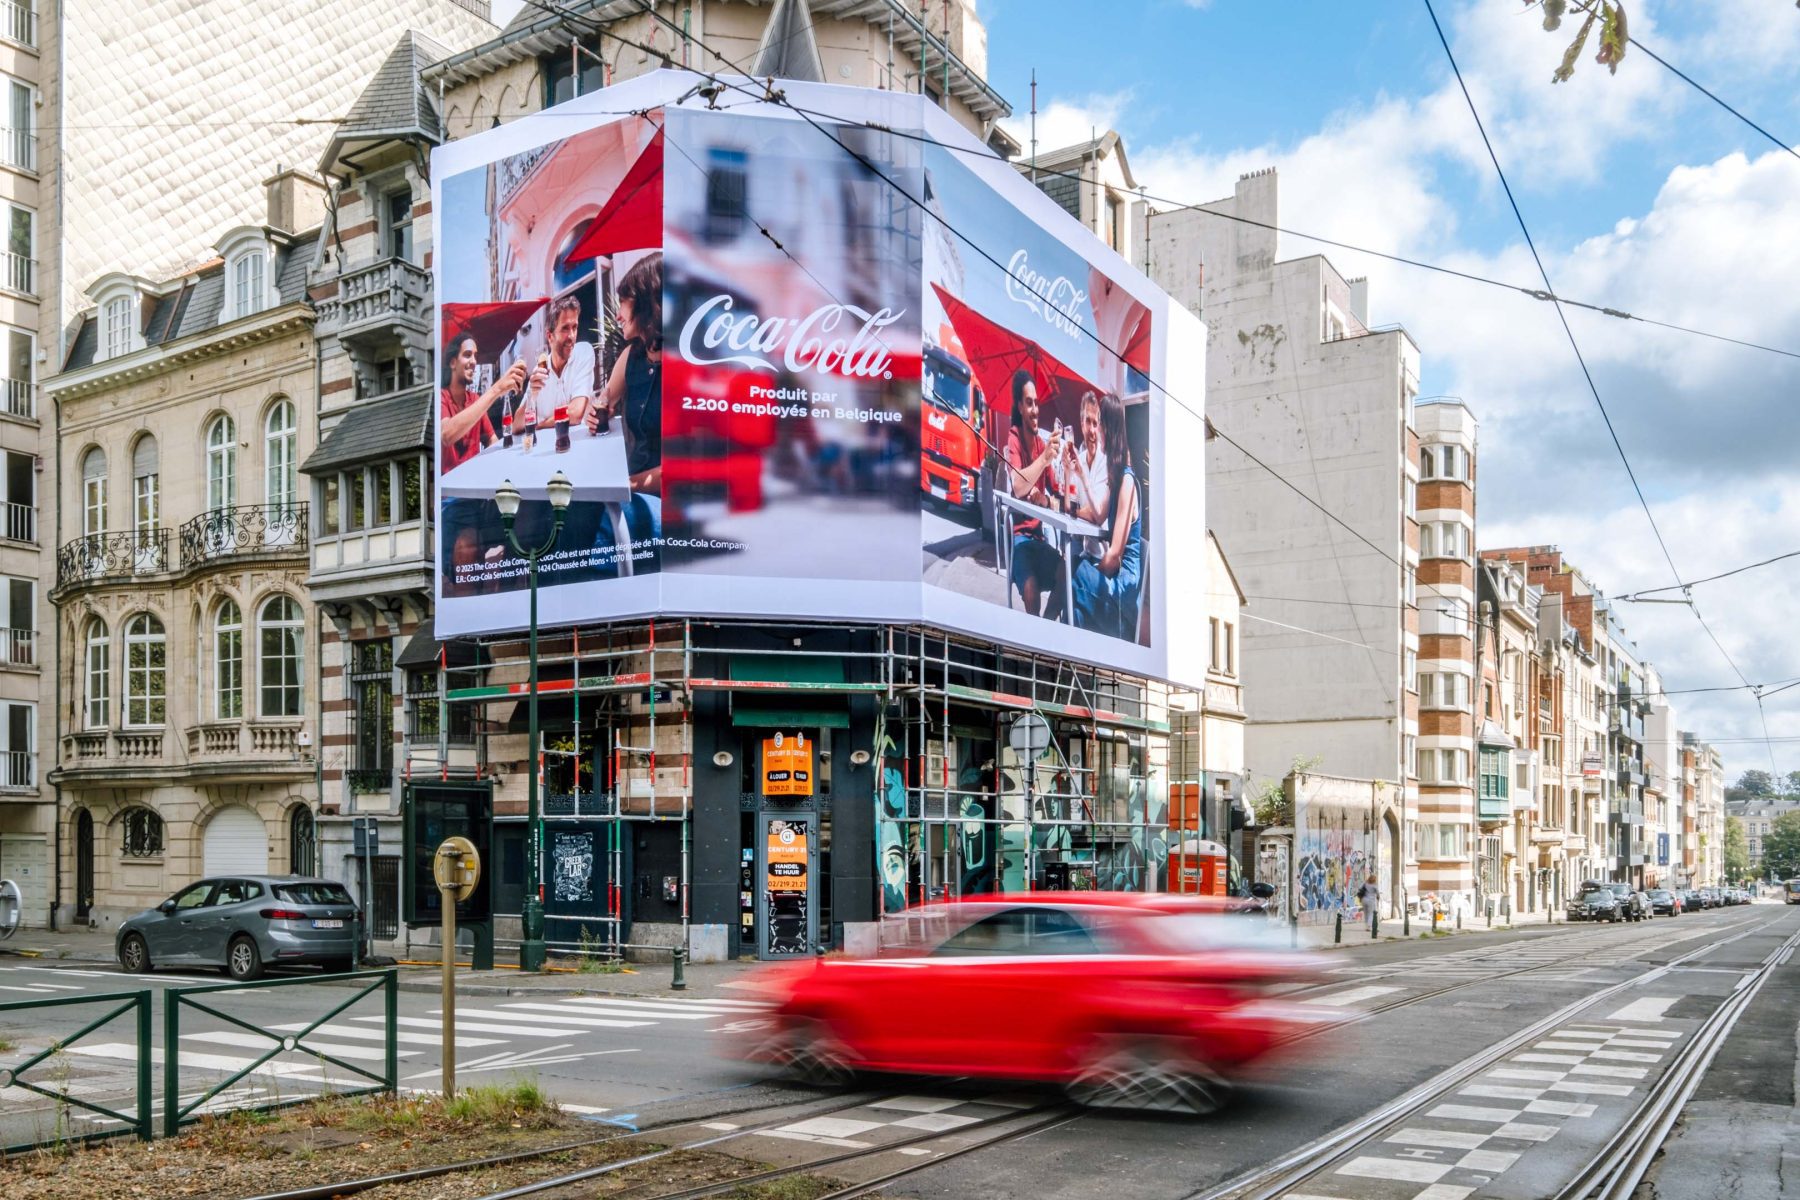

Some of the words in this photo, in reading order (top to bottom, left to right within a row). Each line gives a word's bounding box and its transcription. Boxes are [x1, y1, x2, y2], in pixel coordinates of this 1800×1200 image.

[749, 385, 807, 401] Produit
[811, 390, 838, 404] par
[682, 397, 728, 412] 2.200
[731, 401, 808, 418] employés
[811, 407, 830, 419] en
[835, 407, 903, 423] Belgique
[461, 564, 473, 573] 2025
[474, 562, 485, 571] The
[484, 559, 512, 570] Coca-Cola
[569, 550, 578, 558] est
[579, 547, 590, 556] une
[591, 545, 615, 555] marque
[642, 539, 652, 548] de
[652, 537, 665, 546] The
[666, 537, 708, 548] Coca-Cola
[467, 572, 493, 582] Coca-Cola
[493, 569, 515, 579] Services
[551, 560, 579, 571] Chaussée
[579, 558, 588, 567] de
[588, 557, 605, 566] Mons
[610, 554, 625, 564] 1070
[569, 864, 582, 877] LAB
